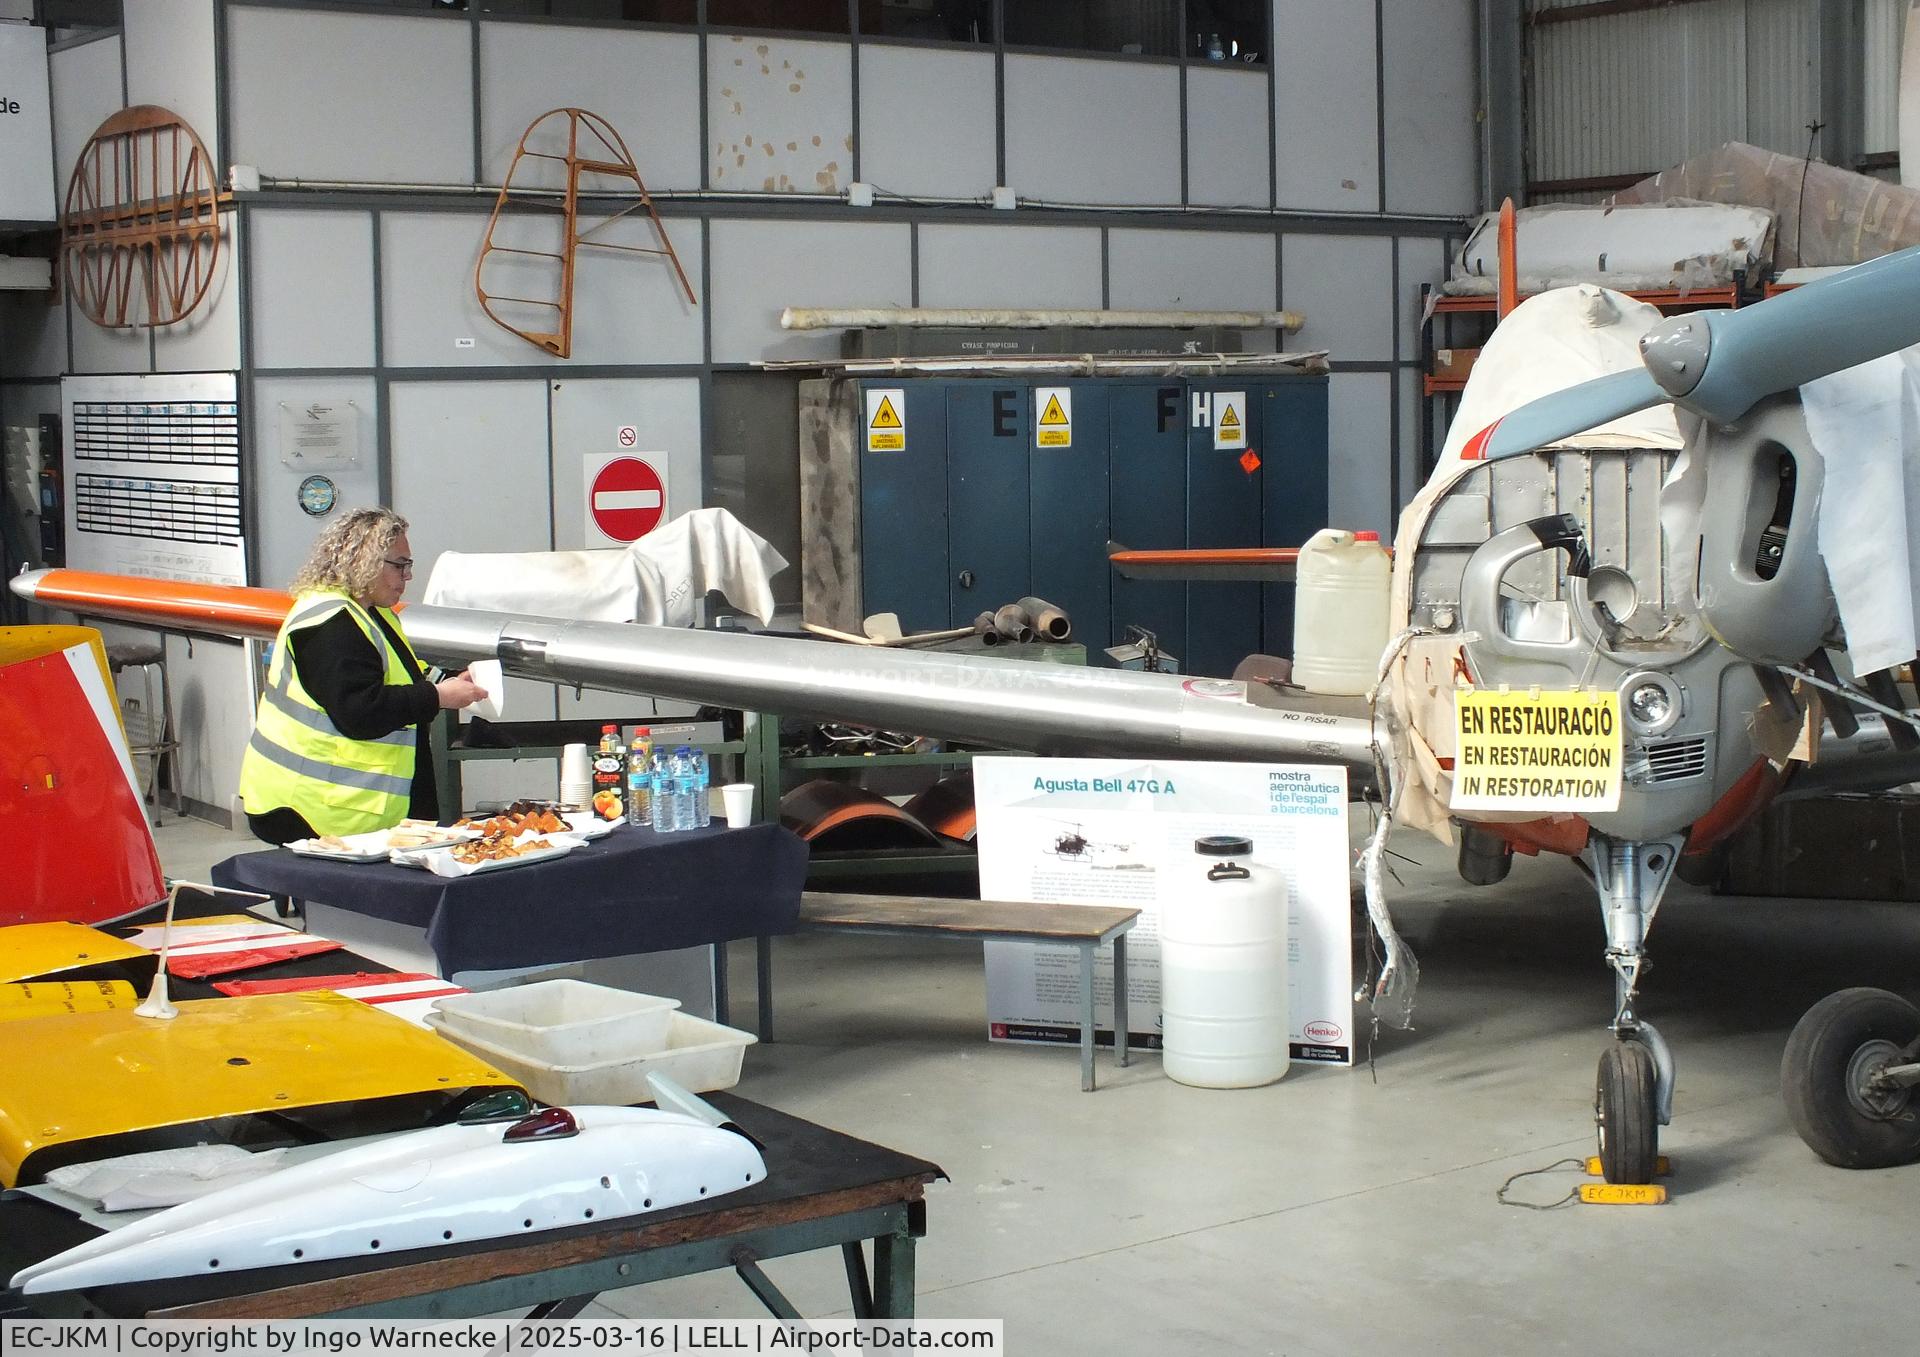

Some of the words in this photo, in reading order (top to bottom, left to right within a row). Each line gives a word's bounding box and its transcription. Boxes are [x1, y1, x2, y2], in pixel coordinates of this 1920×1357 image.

[993, 391, 1017, 436] E
[1157, 388, 1180, 432] F
[1192, 392, 1211, 427] H
[1304, 715, 1338, 725] PISAR
[1461, 706, 1484, 734] EN
[1490, 700, 1613, 736] RESTAURACIÓ
[1464, 746, 1484, 765] EN
[1490, 744, 1610, 767] RESTAURACIÓN
[1033, 776, 1089, 793] Agusta
[1093, 778, 1122, 792] Bell
[1126, 780, 1159, 793] 47G
[1163, 780, 1176, 794] A
[1269, 772, 1311, 781] mostra
[1270, 782, 1340, 793] aeronàutica
[1463, 777, 1480, 795] IN
[1486, 778, 1606, 798] RESTORATION
[1279, 803, 1338, 815] barcelona
[1307, 1027, 1339, 1037] Henkel
